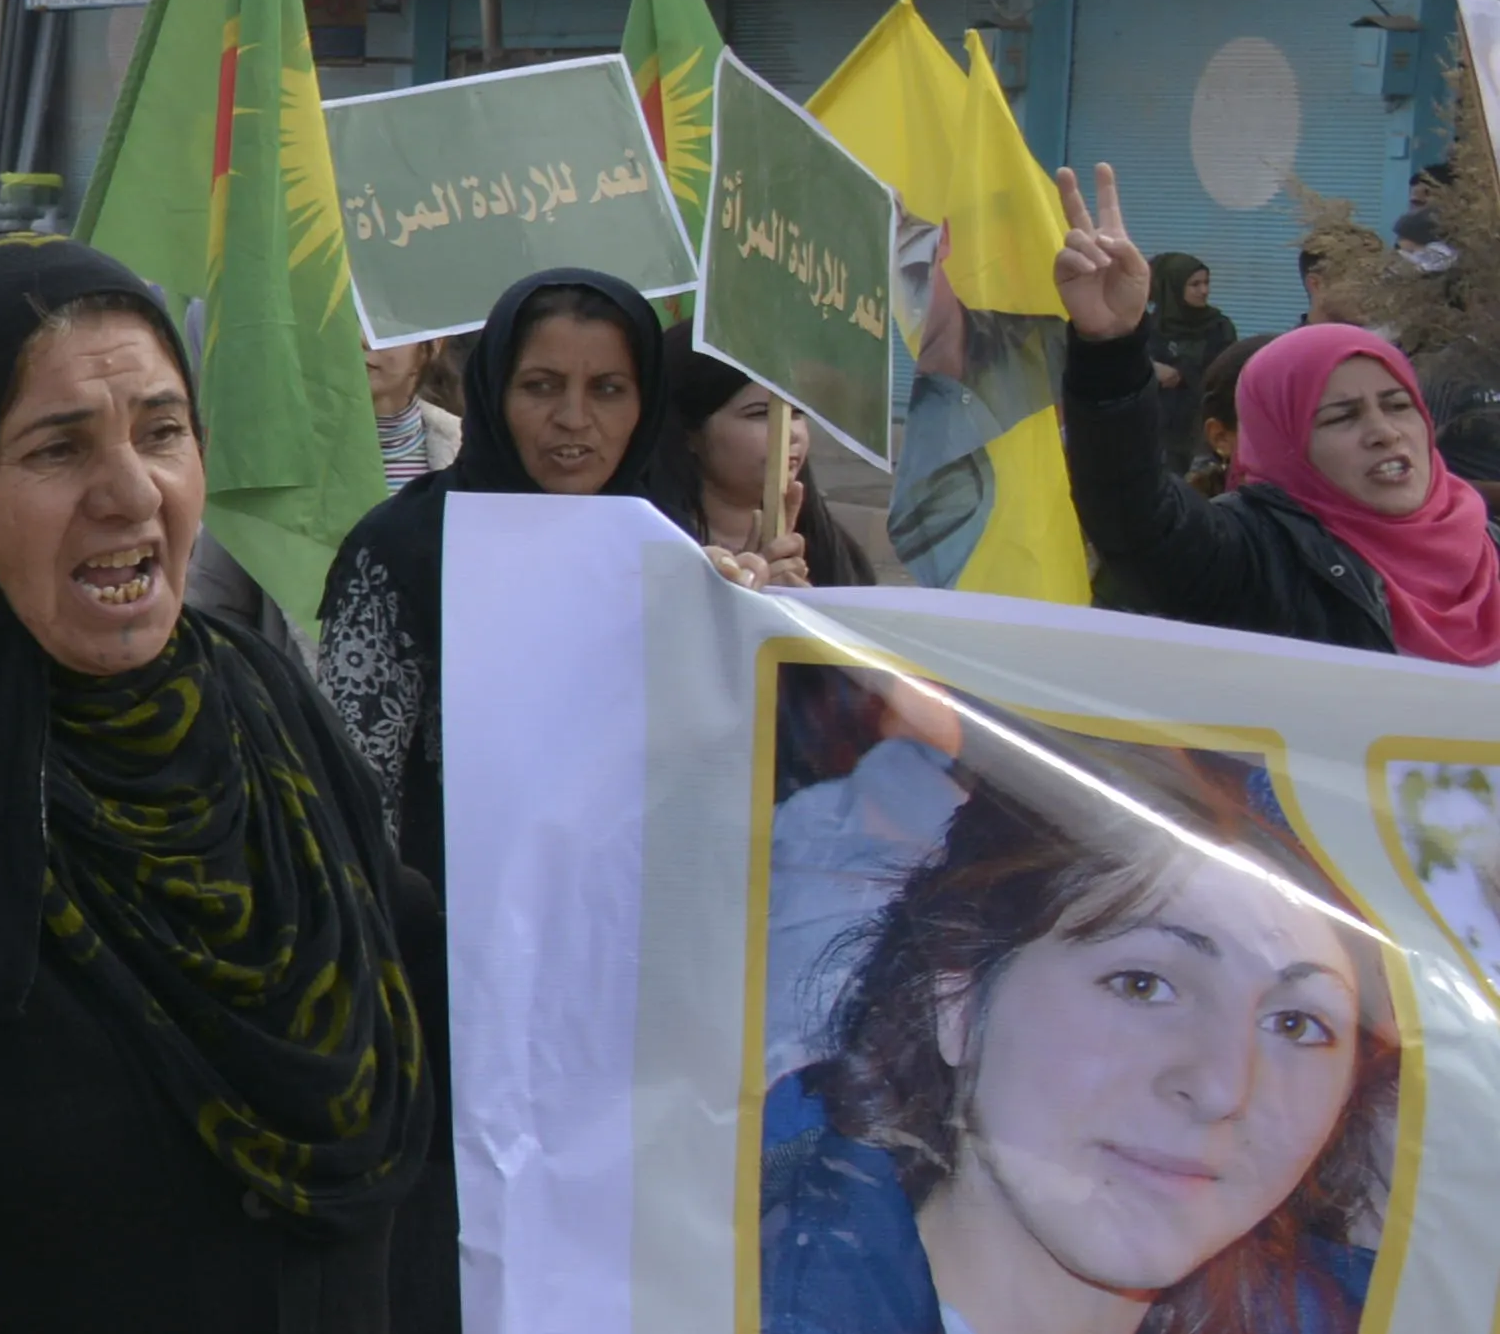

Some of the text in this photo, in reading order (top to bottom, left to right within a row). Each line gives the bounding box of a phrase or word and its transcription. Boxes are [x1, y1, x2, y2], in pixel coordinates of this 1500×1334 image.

[345, 148, 649, 248] نعم للإرادة المرأة
[721, 170, 886, 341] نعم للإرادة المرأة
